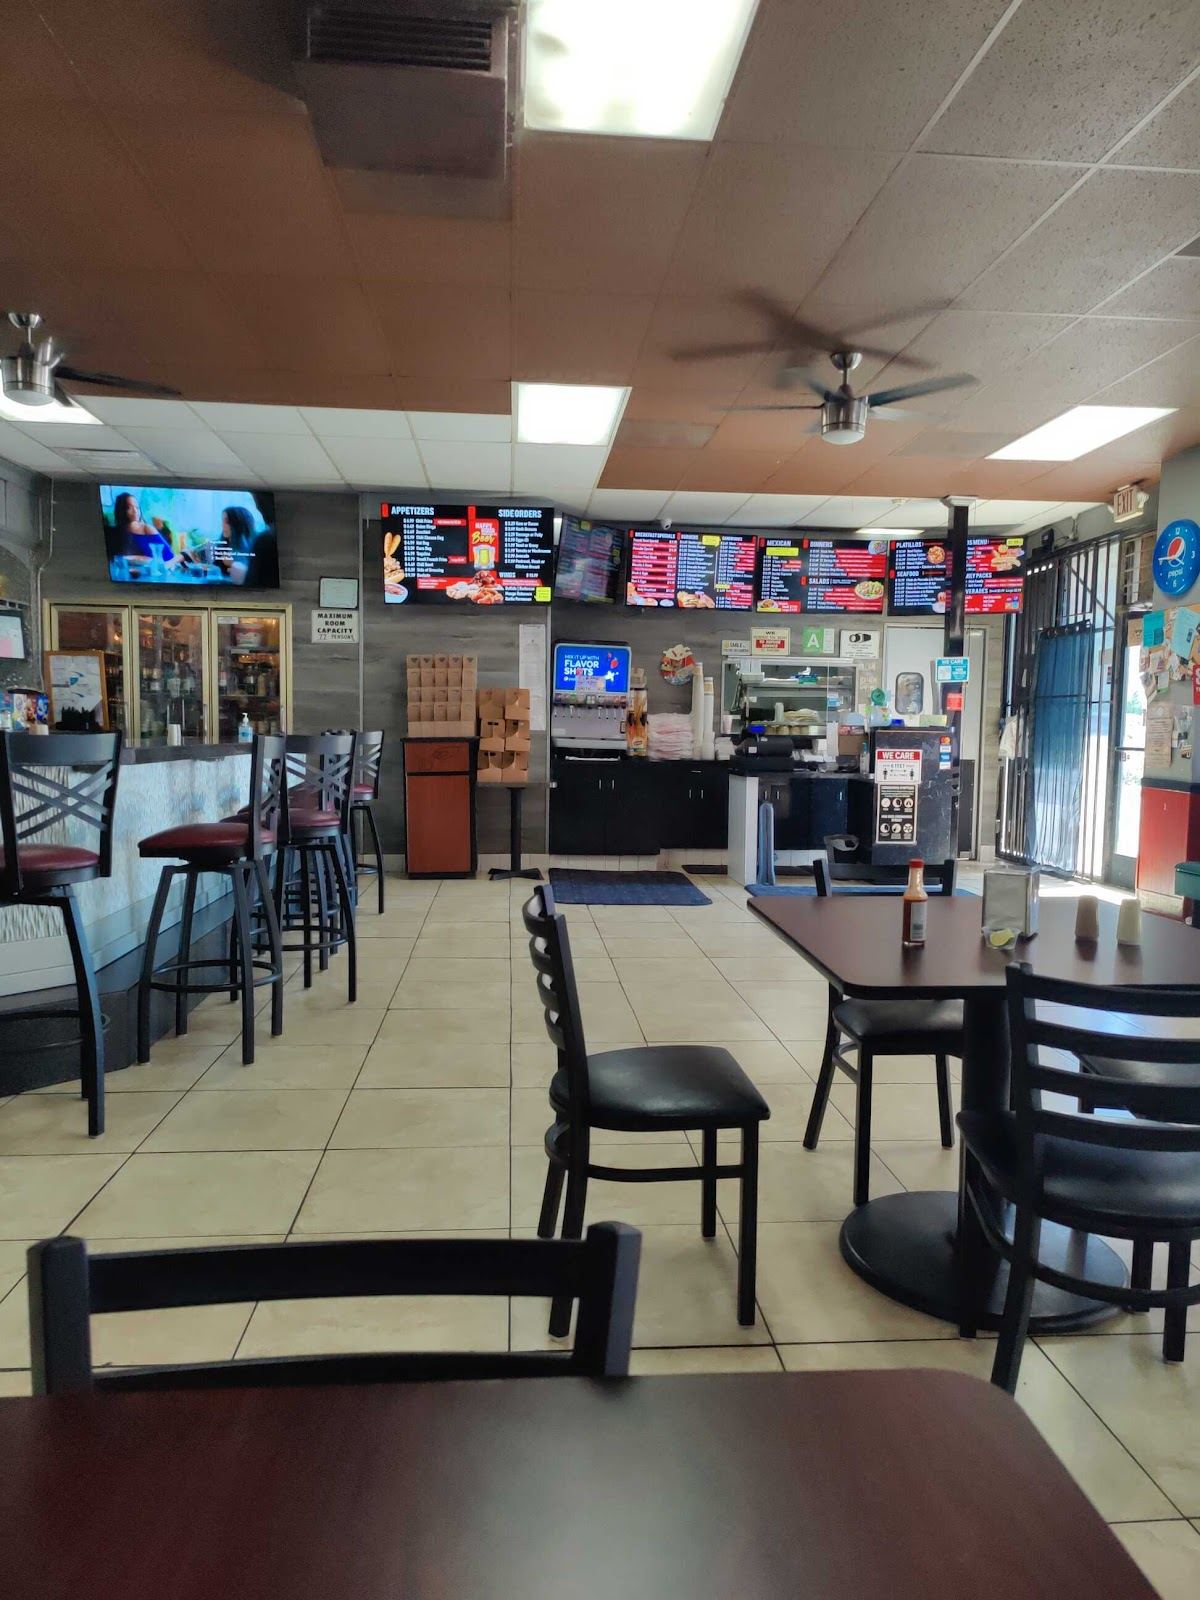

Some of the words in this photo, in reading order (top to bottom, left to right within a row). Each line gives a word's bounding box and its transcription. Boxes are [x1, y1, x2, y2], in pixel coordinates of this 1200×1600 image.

[1117, 488, 1134, 516] EXIT
[391, 506, 434, 515] APPETIZERS
[498, 509, 514, 517] SIDE
[514, 510, 542, 518] ORDERS
[1168, 570, 1183, 578] pepsi
[808, 634, 820, 648] A
[564, 659, 599, 668] FLAVOR
[564, 667, 593, 676] SHOTS
[895, 752, 914, 760] CARE
